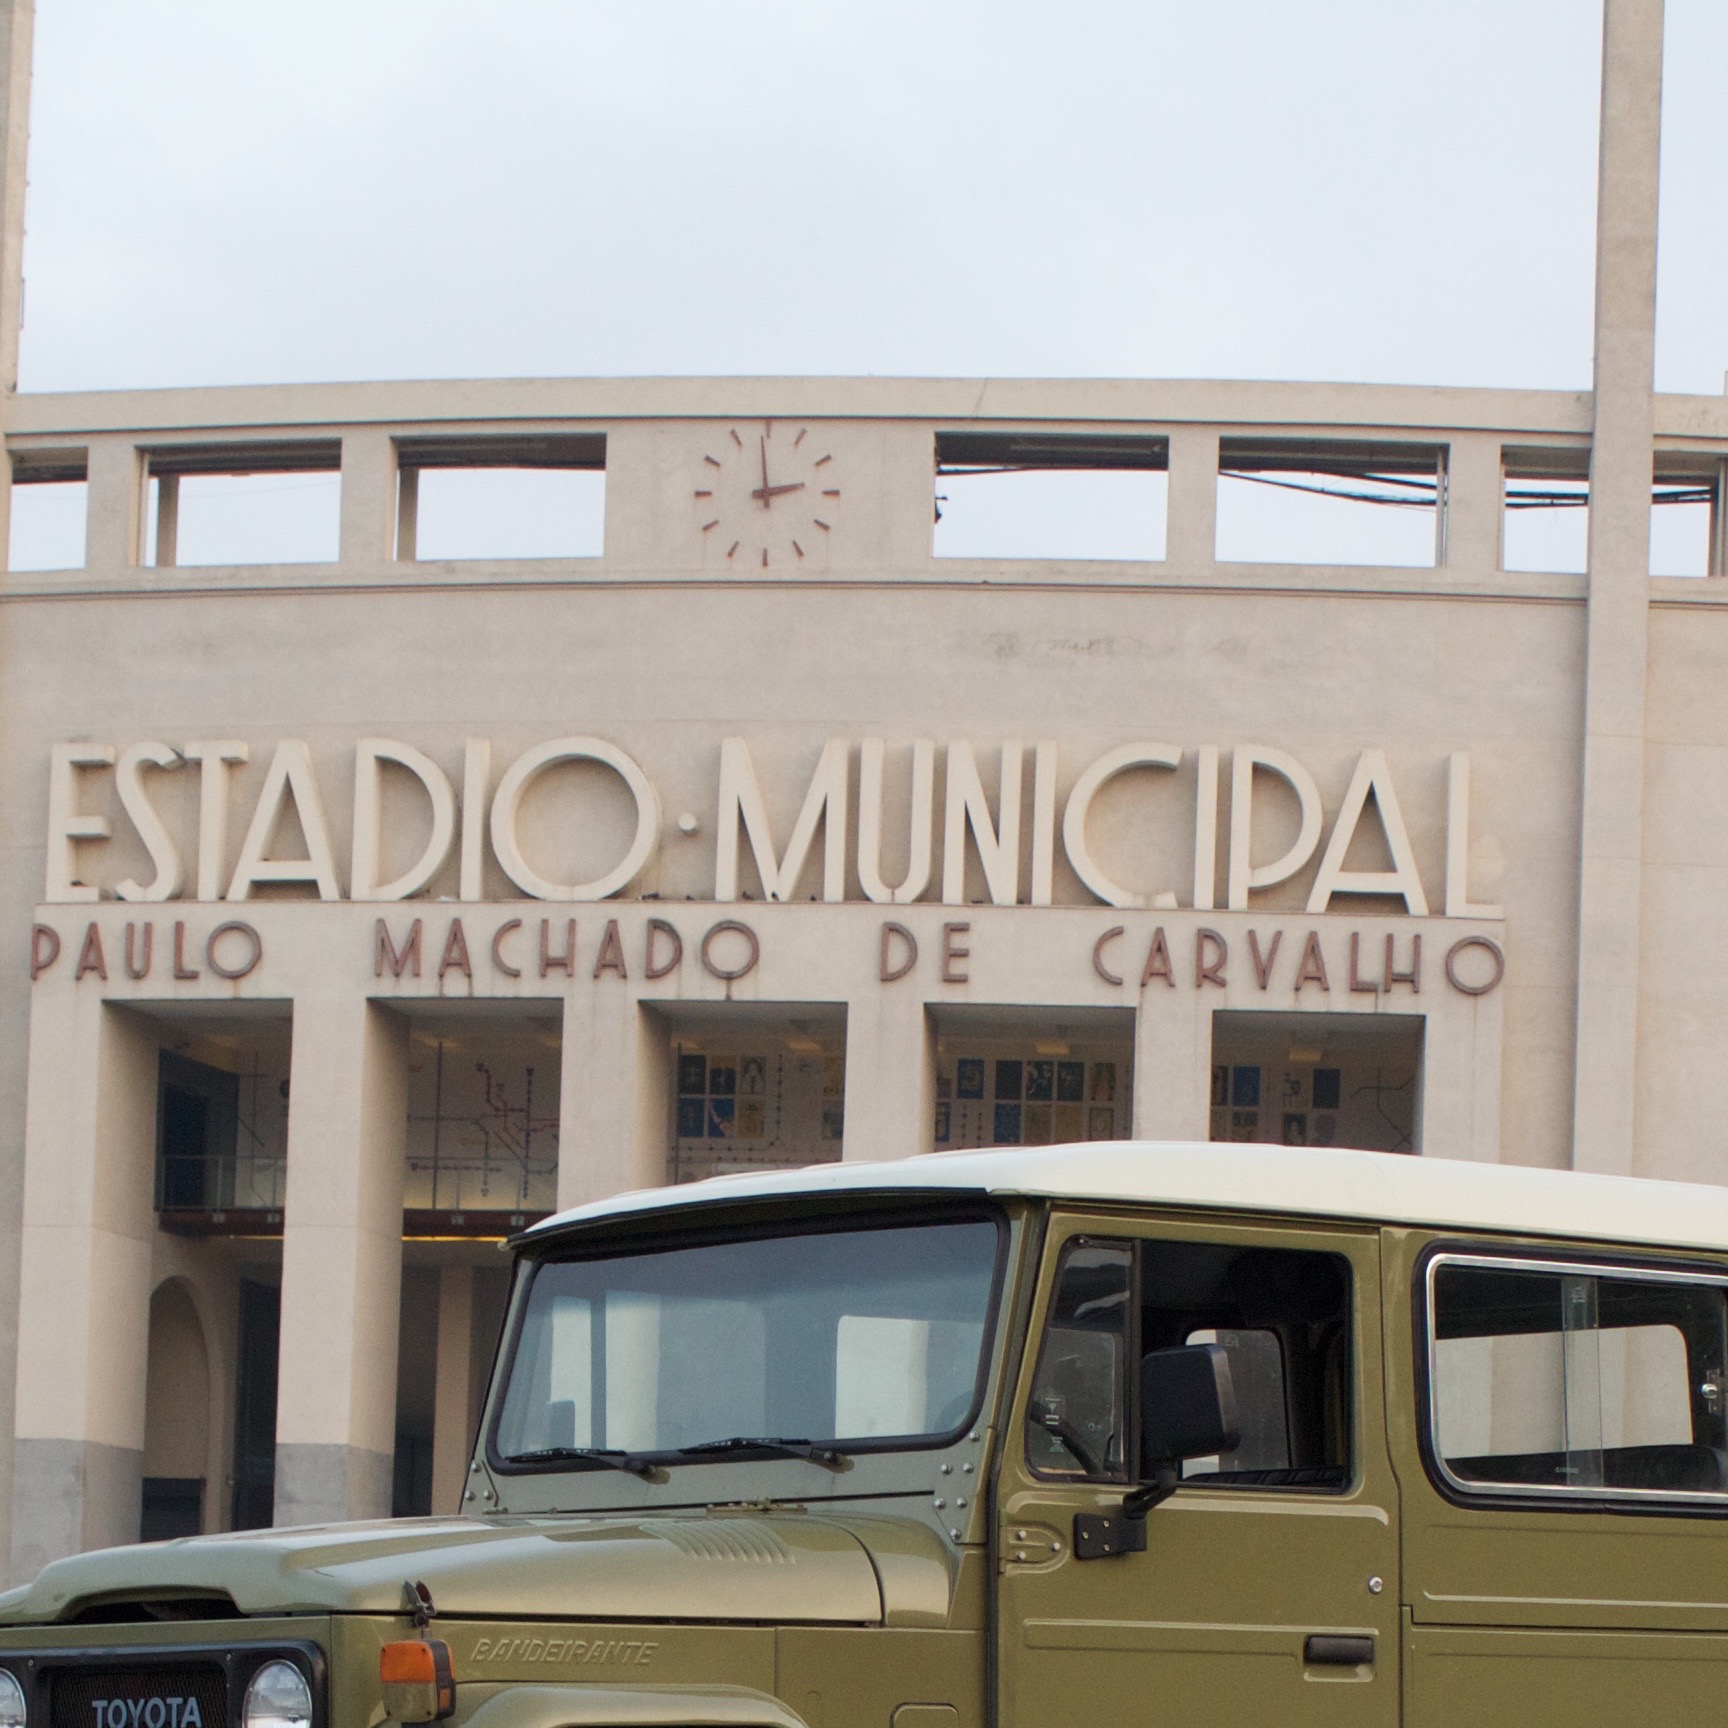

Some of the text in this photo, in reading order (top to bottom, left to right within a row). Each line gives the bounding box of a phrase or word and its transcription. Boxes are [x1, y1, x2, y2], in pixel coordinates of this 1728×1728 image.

[45, 736, 1505, 921] ESTADIO MUNICIPAL
[30, 917, 1506, 997] PAULO MACHADO DE CARVALHO
